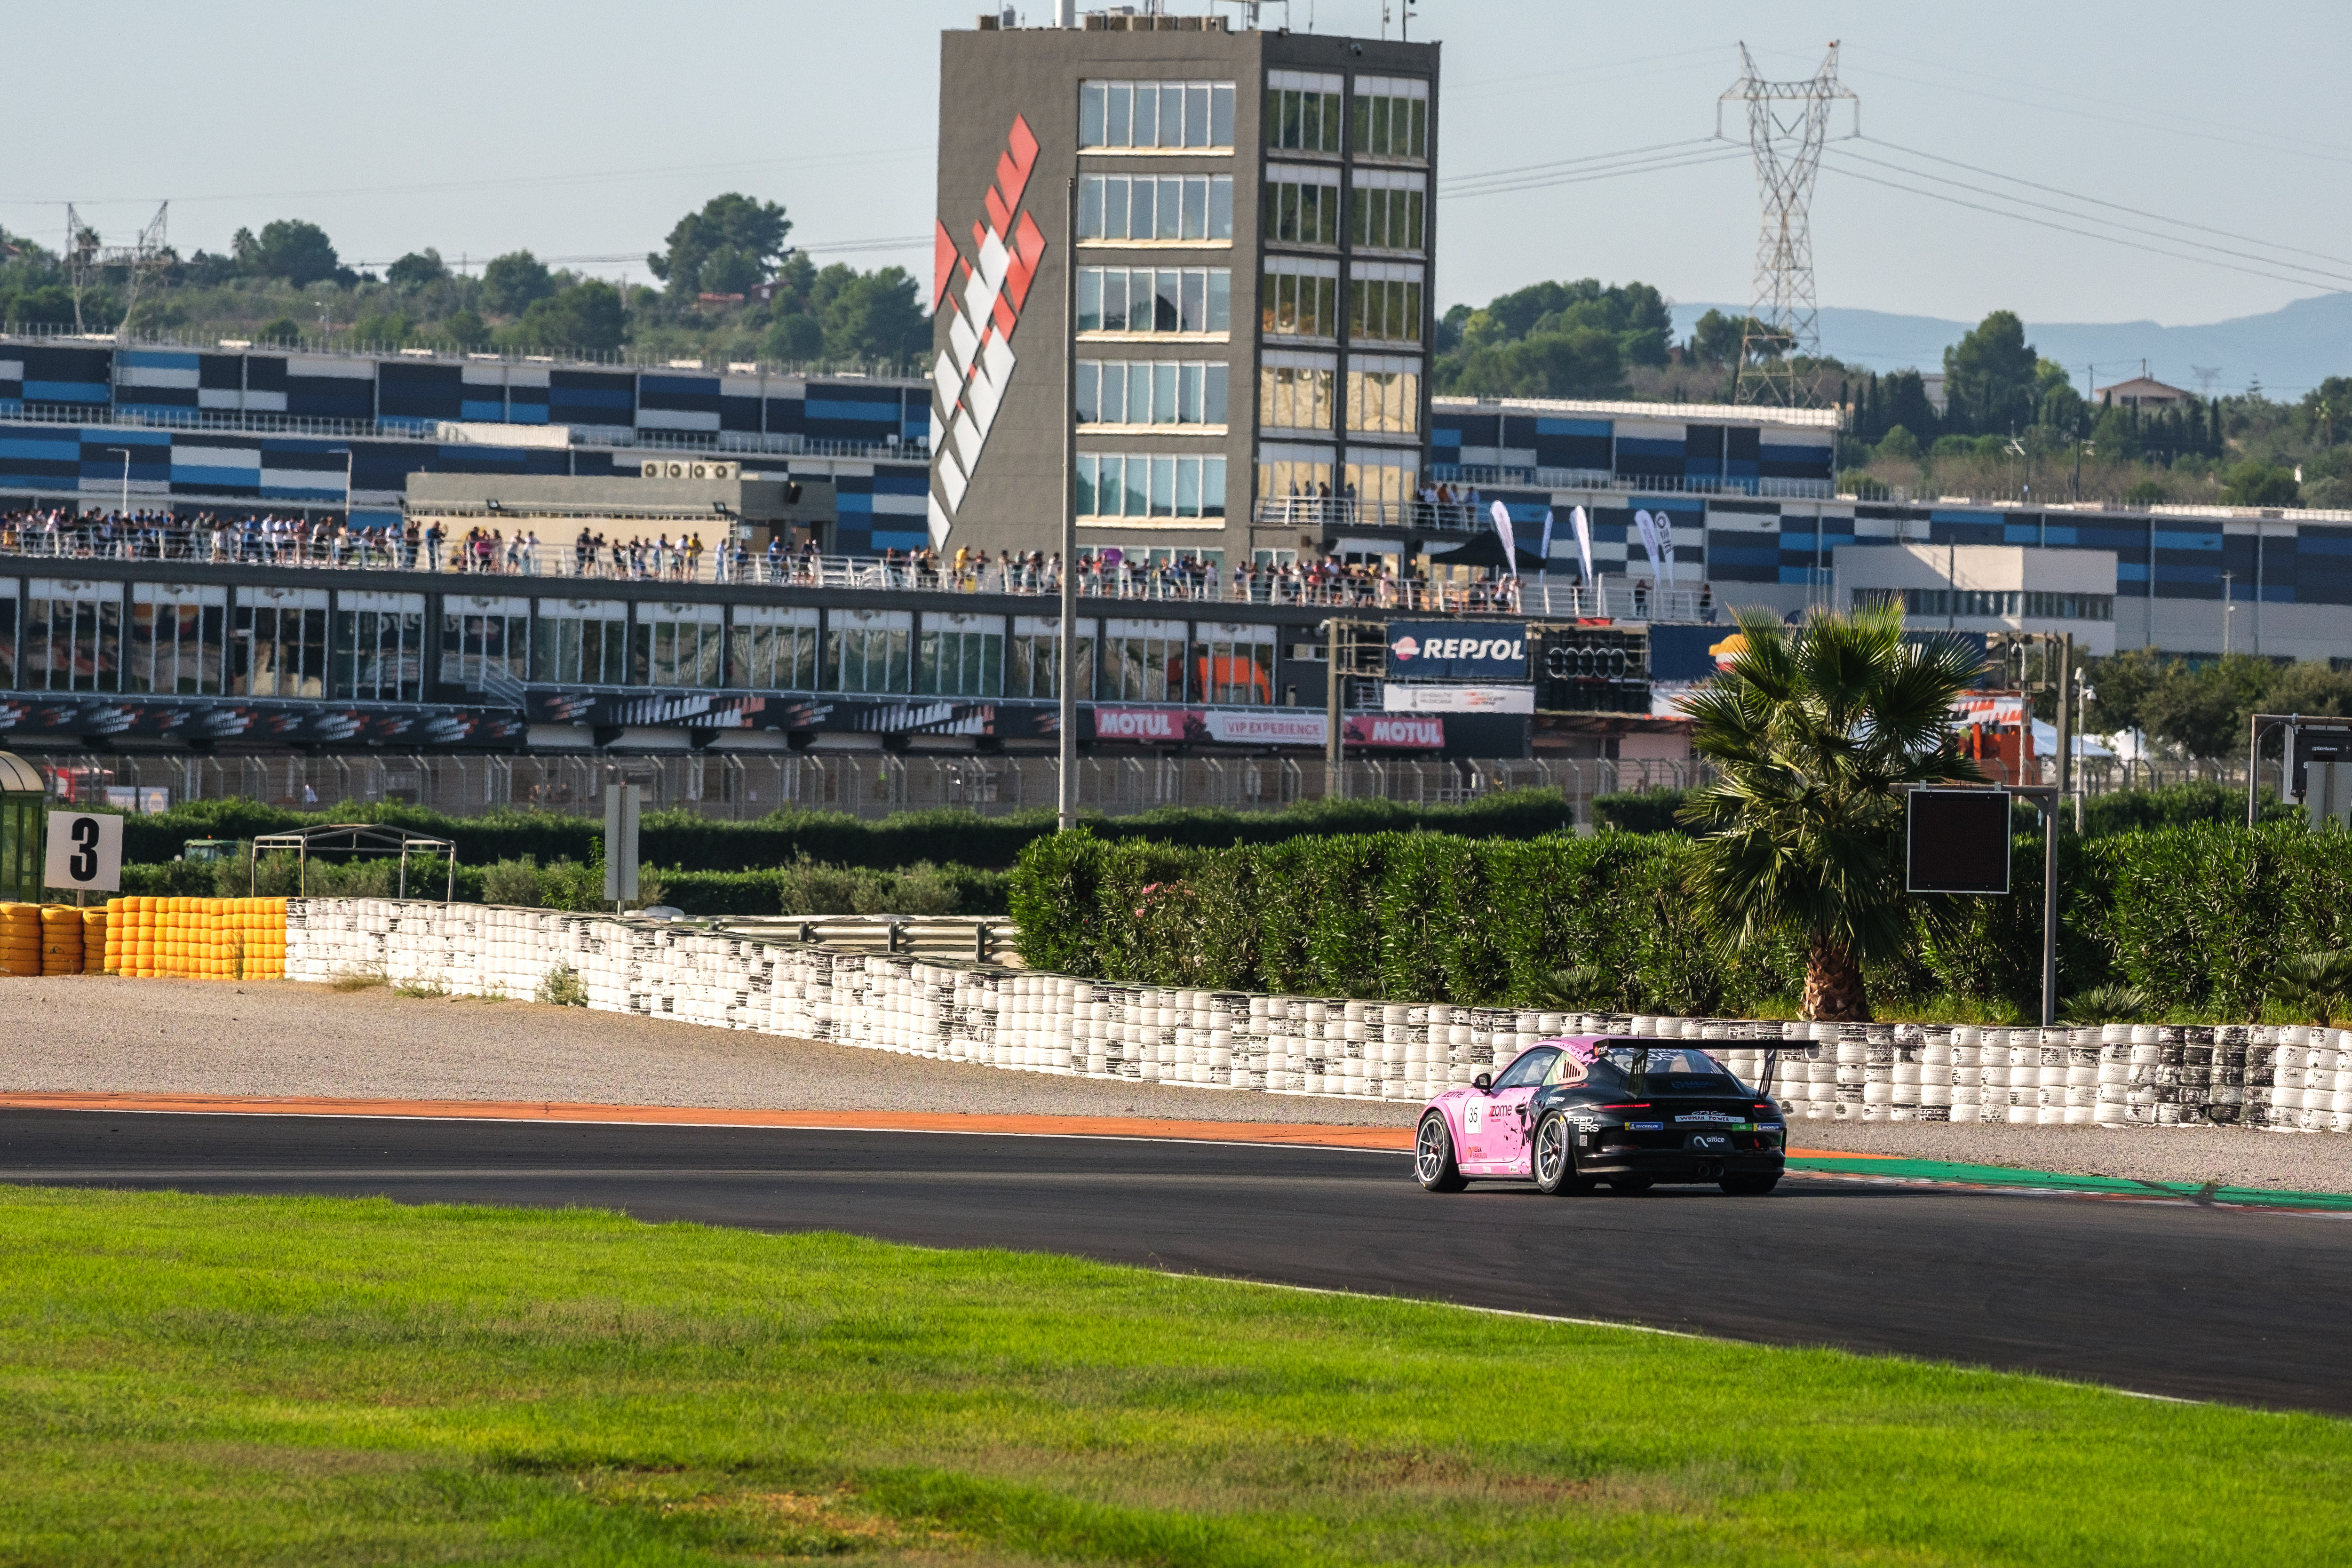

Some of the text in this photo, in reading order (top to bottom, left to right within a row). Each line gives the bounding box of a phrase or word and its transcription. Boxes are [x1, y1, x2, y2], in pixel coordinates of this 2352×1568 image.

[1423, 638, 1525, 660] REPSOL
[1100, 713, 1171, 735] MOTUL
[1228, 722, 1319, 735] VIP EXPERIENCE
[1372, 722, 1440, 744] MOTUL
[70, 817, 100, 882] 3
[1469, 1107, 1478, 1122] 35
